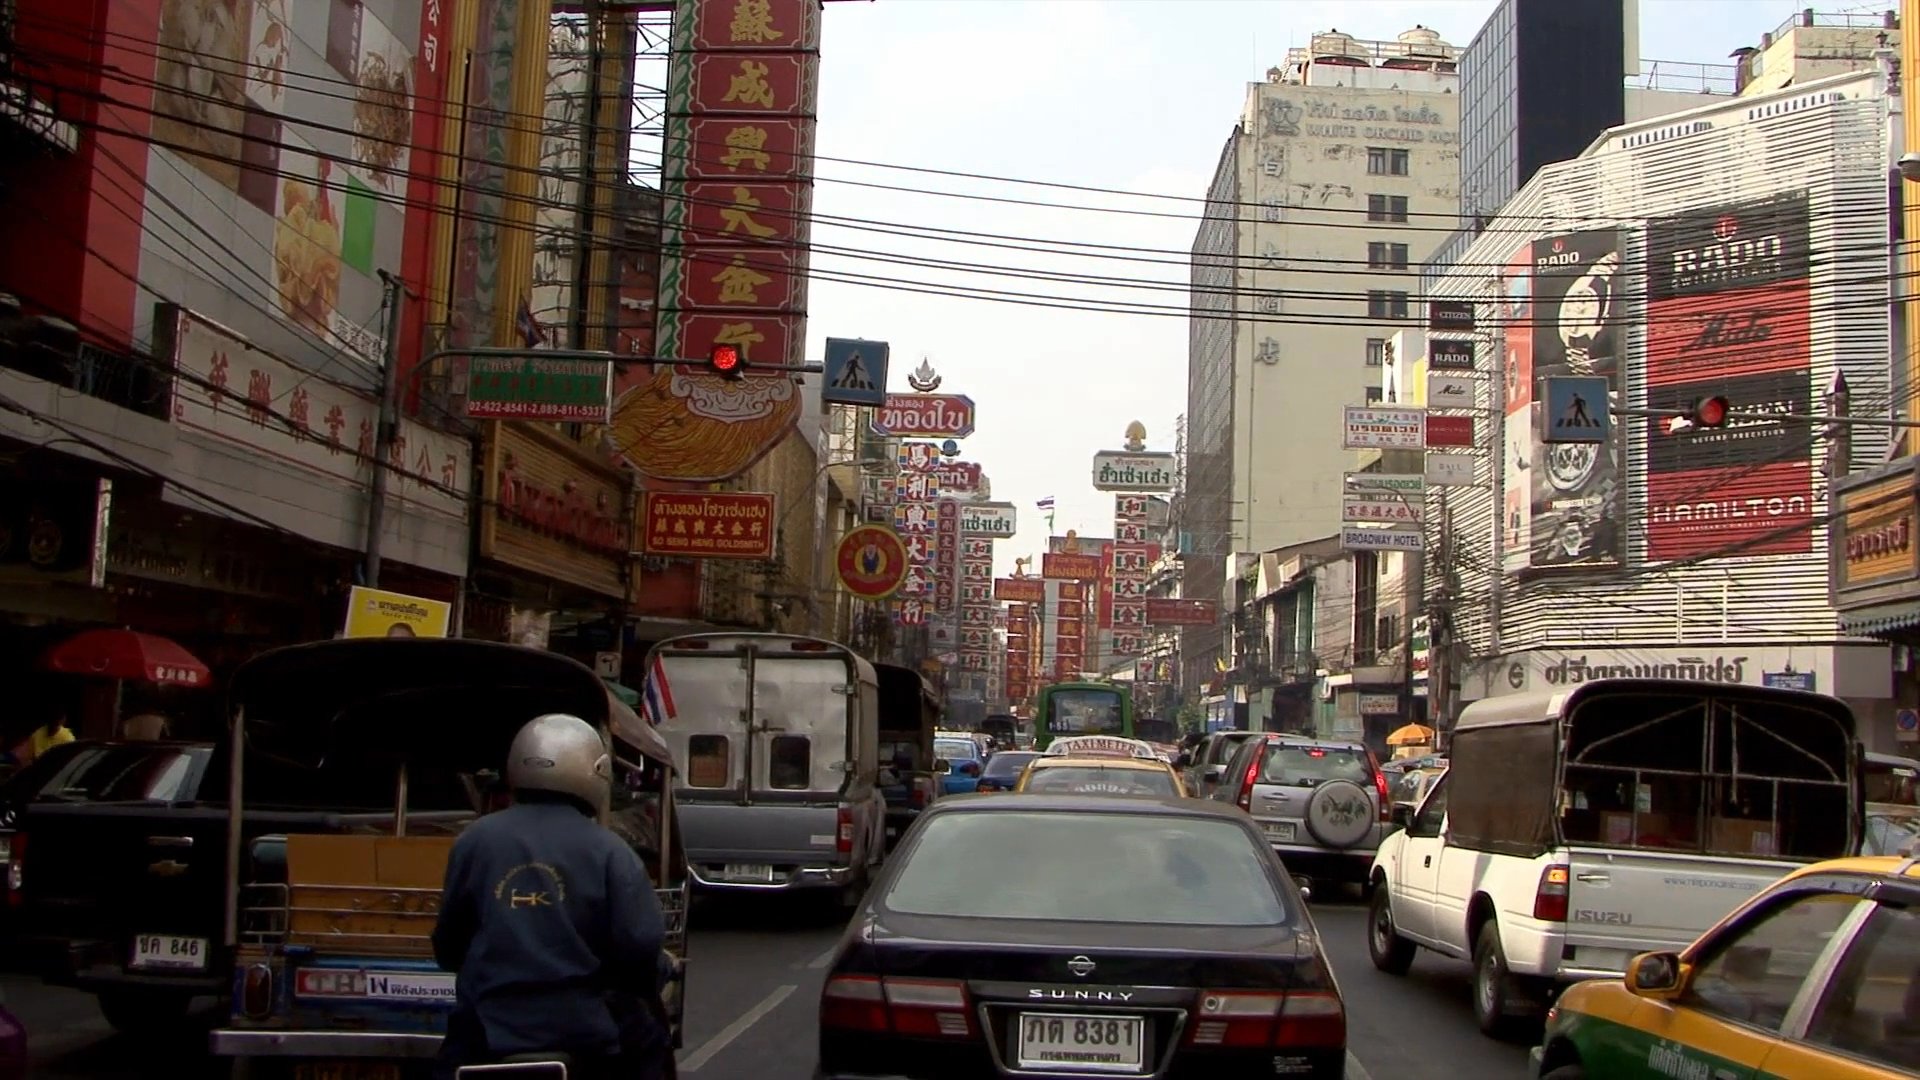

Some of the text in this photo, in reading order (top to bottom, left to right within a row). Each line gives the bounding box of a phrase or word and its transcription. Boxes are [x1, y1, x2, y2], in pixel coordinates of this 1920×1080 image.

[1537, 251, 1580, 269] RADO
[1672, 235, 1781, 275] RADO
[1439, 311, 1471, 320] CITIZEN
[1435, 353, 1469, 363] RADO
[1438, 384, 1466, 395] Mido
[882, 399, 964, 430] ทองใบ
[1653, 496, 1806, 521] HAMILTON
[716, 539, 764, 549] GOLDSMITH
[1345, 533, 1421, 547] BROADWAY HOTEL
[1575, 910, 1633, 926] ISUZU
[171, 938, 198, 956] 846
[1029, 988, 1134, 1002] SUNNY
[1074, 1020, 1134, 1046] 8381
